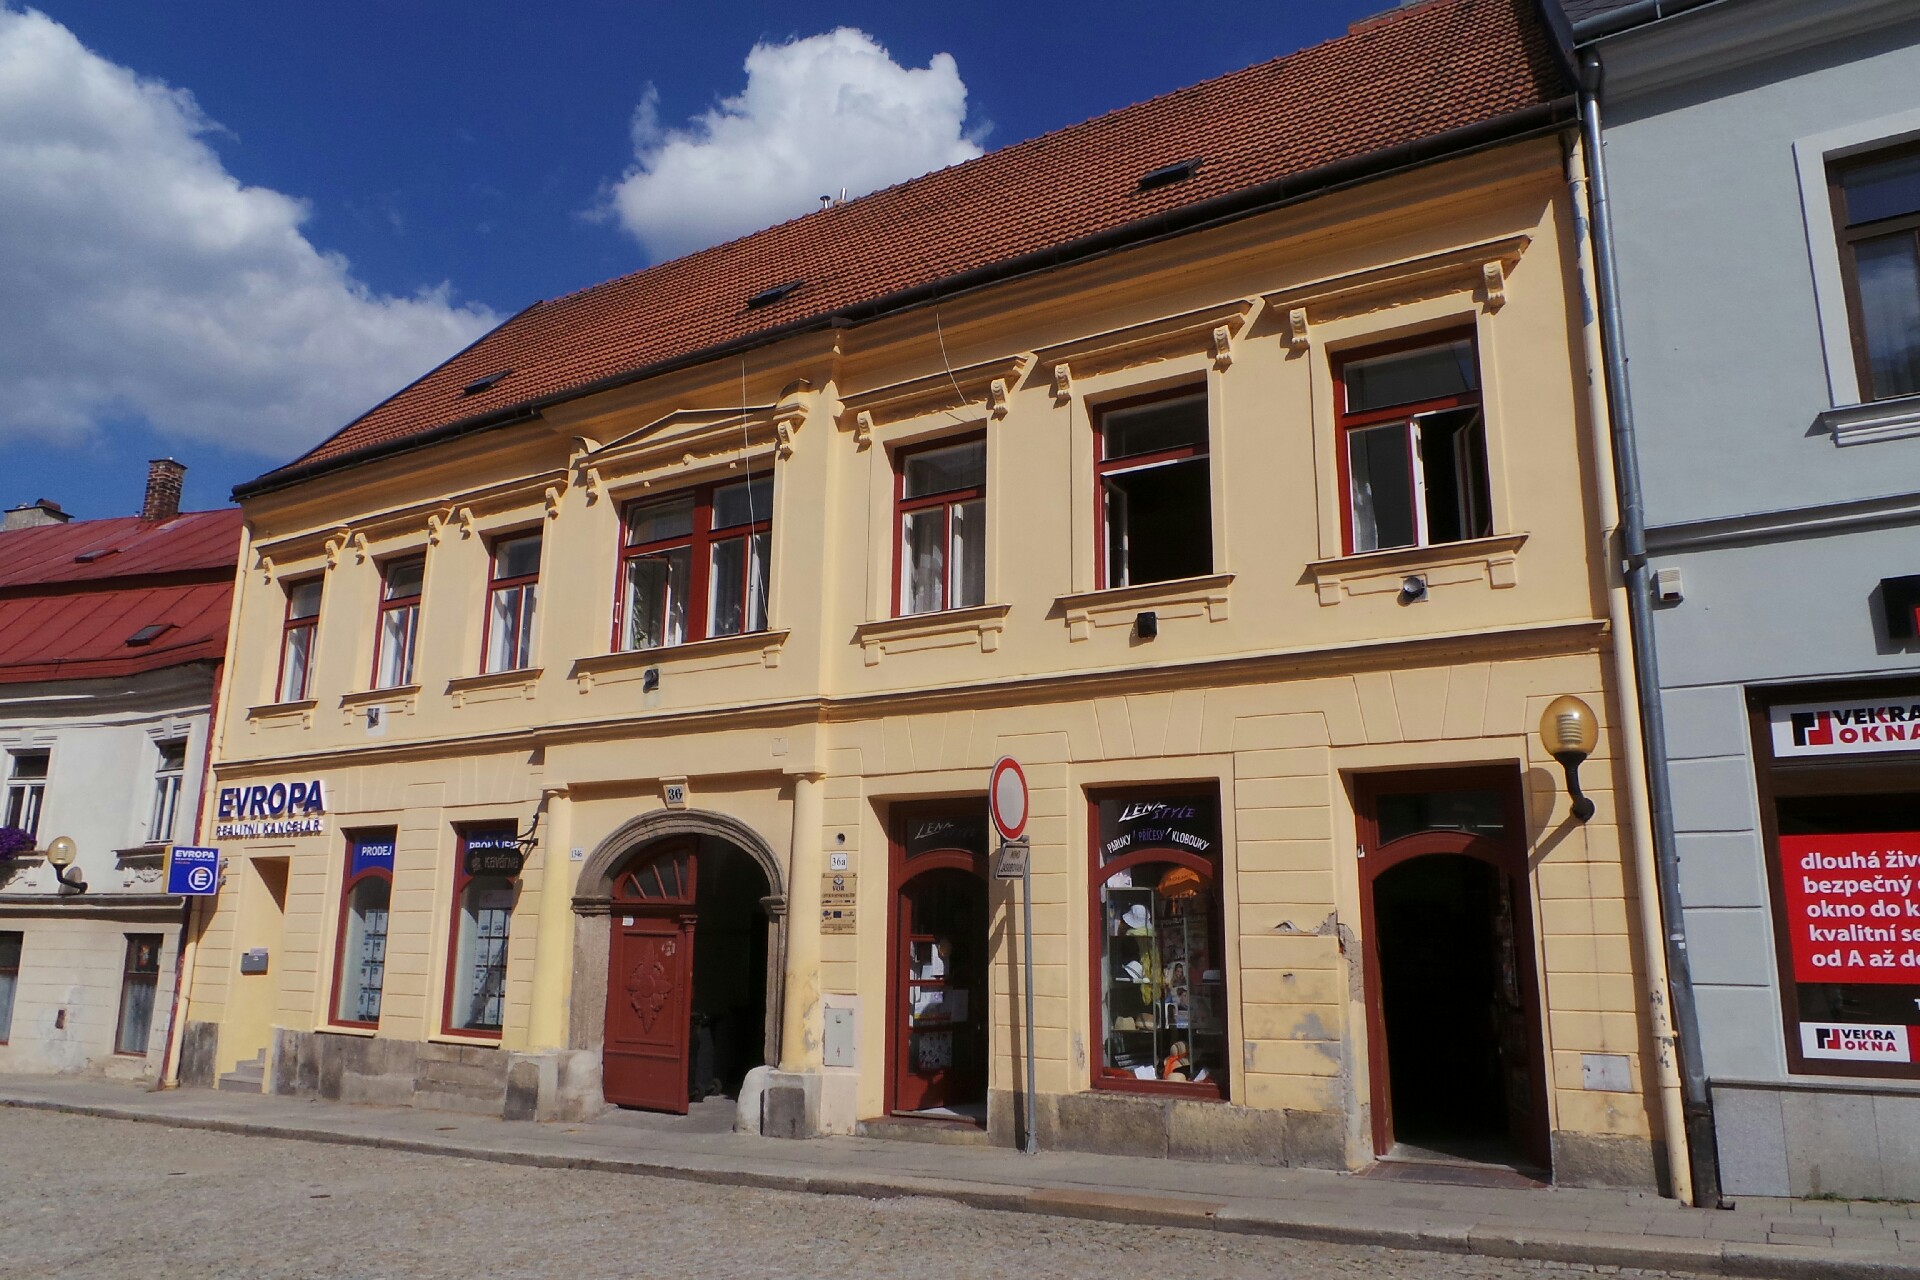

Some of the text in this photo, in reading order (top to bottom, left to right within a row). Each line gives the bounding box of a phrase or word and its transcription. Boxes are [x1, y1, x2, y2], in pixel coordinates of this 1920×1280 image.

[218, 780, 323, 817] EVROPA
[668, 788, 682, 800] 36
[1118, 802, 1196, 822] LENA STYLE
[914, 822, 954, 840] LENA
[361, 845, 392, 856] PRODEJ
[1106, 834, 1131, 853] PARUKY
[1171, 831, 1210, 851] KLOBOUKY
[175, 850, 215, 859] EVROPA
[831, 857, 846, 867] 36a
[1801, 850, 1920, 870] dlouhá živ
[1803, 875, 1912, 897] bezpečný
[1807, 900, 1866, 917] okno
[1870, 900, 1901, 917] do
[1809, 924, 1897, 942] kvalitní
[1812, 949, 1842, 967] od
[1848, 950, 1865, 967] A
[1869, 949, 1896, 967] až
[1841, 1029, 1896, 1041] VEKRA
[1844, 1041, 1897, 1052] OKNA
